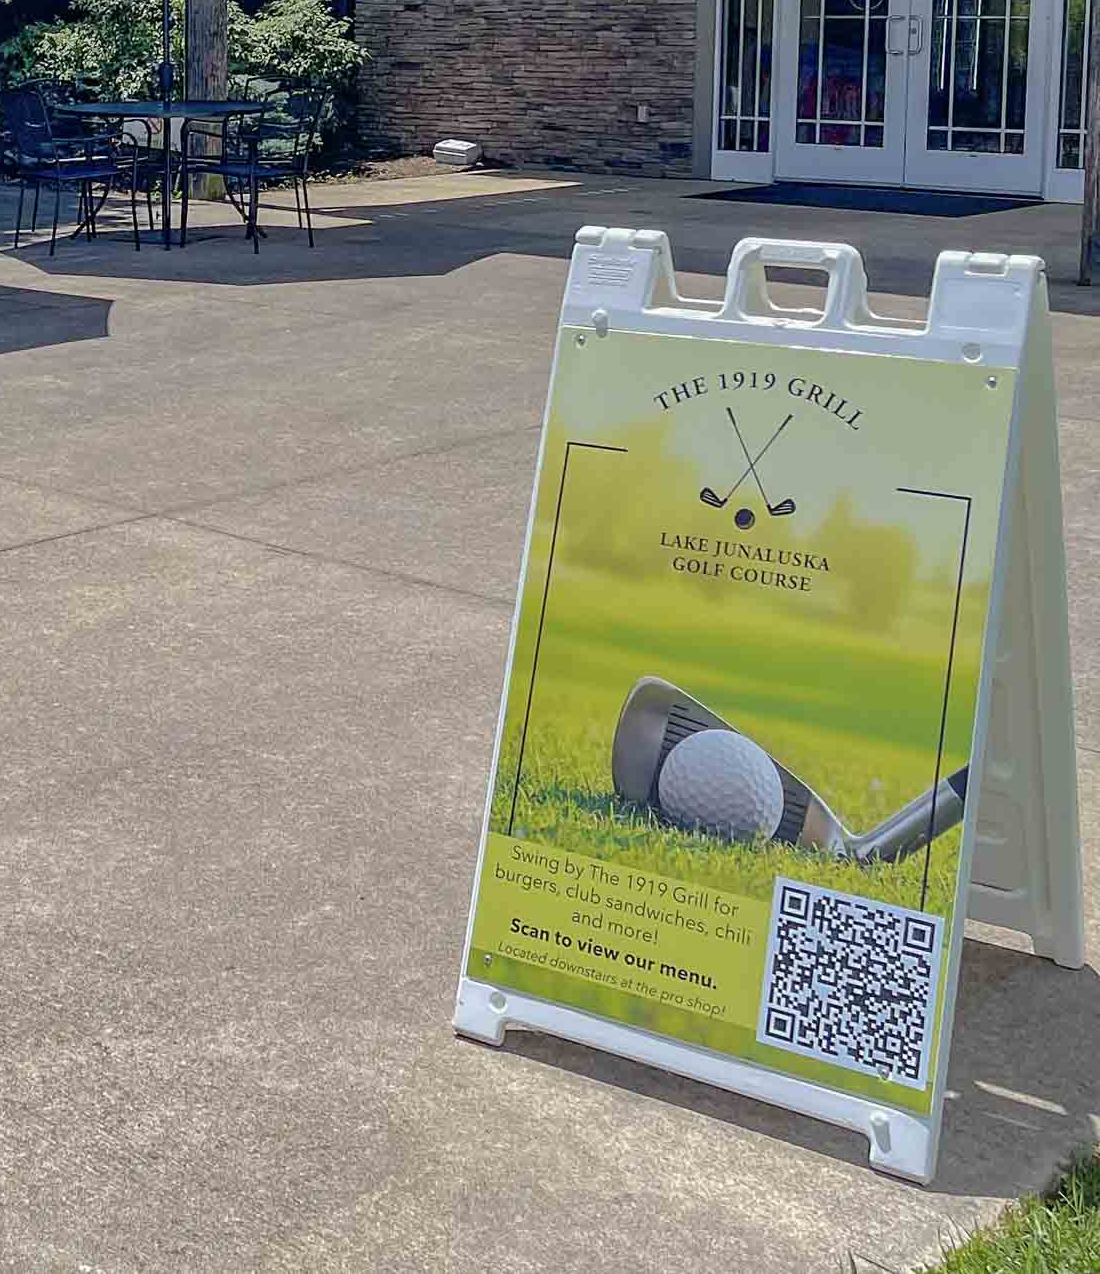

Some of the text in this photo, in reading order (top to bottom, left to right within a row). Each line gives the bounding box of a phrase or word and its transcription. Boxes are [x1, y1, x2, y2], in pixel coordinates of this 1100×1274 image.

[653, 372, 864, 431] THE 1919 GRILL
[660, 532, 830, 571] LAKE JUNALUSKA
[672, 557, 812, 591] GOLF COURSE
[495, 862, 751, 945] burgers, club sandwiches, chili
[512, 845, 740, 918] Swing by The 1919 Grill for
[510, 918, 717, 989] Scan to view our menu.
[571, 910, 659, 945] and more!
[498, 942, 726, 1019] Located downstairs at the pro shop!
